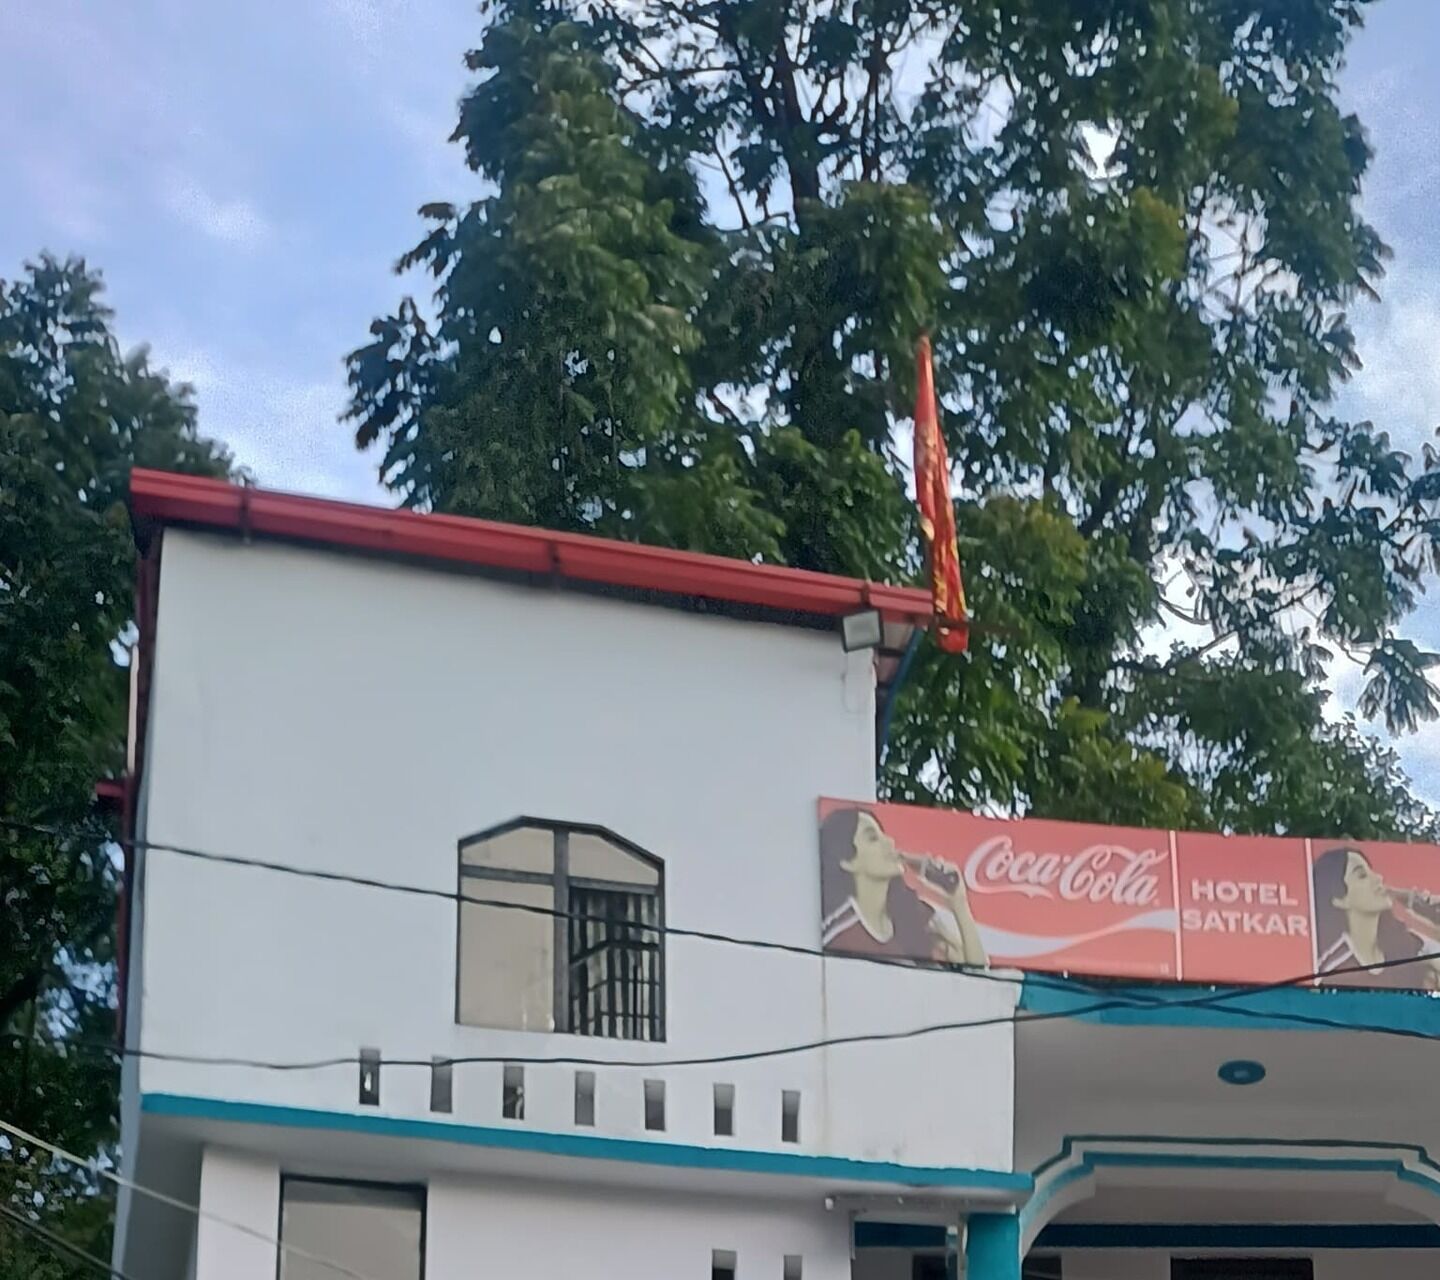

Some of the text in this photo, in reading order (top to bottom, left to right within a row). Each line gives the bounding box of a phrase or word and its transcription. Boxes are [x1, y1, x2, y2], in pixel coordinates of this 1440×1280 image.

[965, 836, 1168, 906] Coca-Cola
[1192, 879, 1298, 907] HOTEL
[1183, 908, 1307, 936] SATKAR
